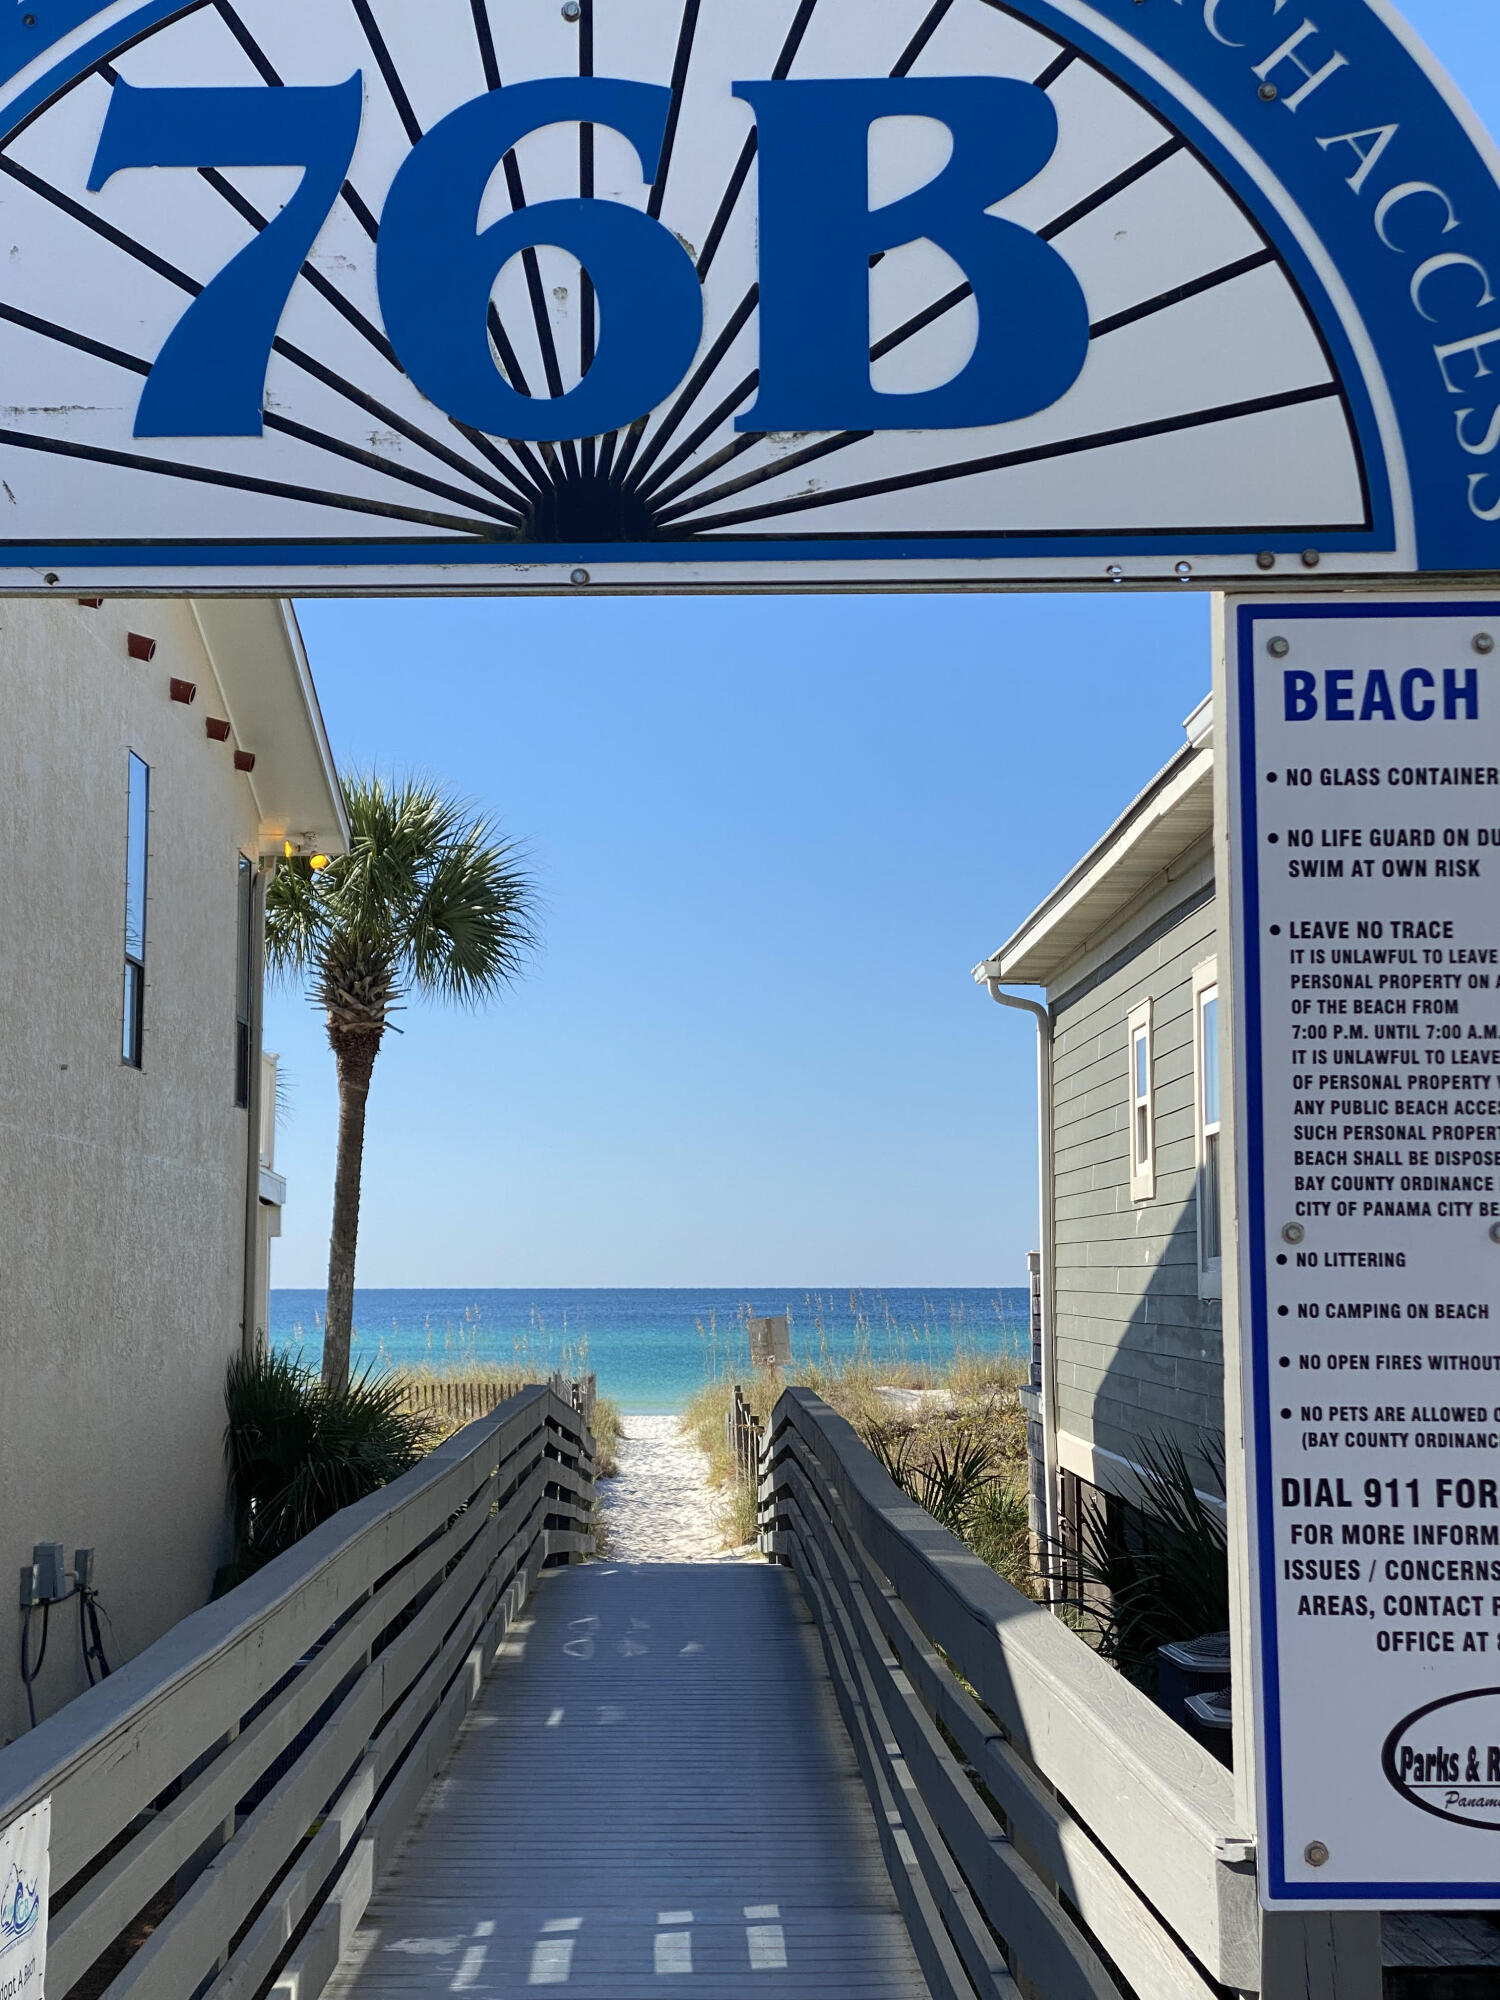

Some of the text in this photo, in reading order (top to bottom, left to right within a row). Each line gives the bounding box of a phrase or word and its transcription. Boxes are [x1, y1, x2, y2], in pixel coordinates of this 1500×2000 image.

[1174, 0, 1350, 114] CH
[86, 68, 1090, 442] 76B
[1284, 668, 1478, 721] BEACH
[1287, 768, 1312, 786] NO
[1320, 768, 1379, 785] GLASS
[1288, 829, 1313, 847] NO
[1322, 830, 1361, 846] LIFE
[1370, 829, 1435, 846] GUARD
[1444, 829, 1468, 846] ON
[1289, 860, 1479, 877] SWIM AT OWN RISK
[1290, 921, 1453, 938] LEAVE NO TRACE
[1291, 949, 1497, 963] IT IS UNLAWFUL TO LEAVE
[1291, 975, 1373, 989] PERSONAL
[1379, 974, 1461, 989] PROPERTY
[1469, 974, 1488, 988] ON
[1292, 999, 1458, 1014] OF THE BEACH FROM
[1292, 1025, 1326, 1039] 7:00
[1334, 1025, 1368, 1039] P.M.
[1375, 1025, 1420, 1039] UNTIL
[1426, 1025, 1461, 1039] 7:00
[1293, 1050, 1500, 1064] IT IS UNLAWFUL TO LEAVE
[1293, 1075, 1312, 1089] OF
[1320, 1075, 1402, 1089] PERSONAL
[1408, 1075, 1490, 1089] PROPERTY
[1294, 1100, 1500, 1115] ANY PUBLIC BEACH ACCE
[1294, 1125, 1336, 1140] SUCH
[1344, 1126, 1426, 1140] PERSONAL
[1295, 1151, 1346, 1165] BEACH
[1354, 1151, 1402, 1165] SHALL
[1409, 1151, 1428, 1165] BE
[1295, 1176, 1325, 1190] BAY
[1332, 1176, 1394, 1190] COUNTY
[1401, 1176, 1493, 1191] ORDINANCE
[1296, 1201, 1331, 1216] CITY
[1337, 1202, 1356, 1216] OF
[1364, 1202, 1431, 1216] PANAMA
[1438, 1202, 1473, 1216] CITY
[1297, 1252, 1405, 1267] NO LITTERING
[1298, 1303, 1488, 1319] NO CAMPING ON BEACH
[1300, 1355, 1320, 1369] NO
[1328, 1355, 1369, 1369] OPEN
[1376, 1355, 1421, 1370] FIRES
[1301, 1406, 1322, 1421] NO
[1329, 1407, 1368, 1421] PETS
[1375, 1407, 1405, 1421] ARE
[1412, 1407, 1487, 1422] ALLOWED
[1302, 1432, 1498, 1450] (BAY COUNTY ORDINANC
[1282, 1478, 1498, 1508] DIAL 911 FOR
[1291, 1524, 1498, 1545] FOR MORE INFORM
[1285, 1560, 1360, 1580] ISSUES
[1369, 1560, 1376, 1582] /
[1298, 1595, 1374, 1619] AREAS,
[1384, 1596, 1483, 1616] CONTACT
[1377, 1631, 1454, 1652] OFFICE
[1463, 1632, 1488, 1651] AT
[1400, 1746, 1459, 1783] Parks
[1466, 1746, 1480, 1782] &
